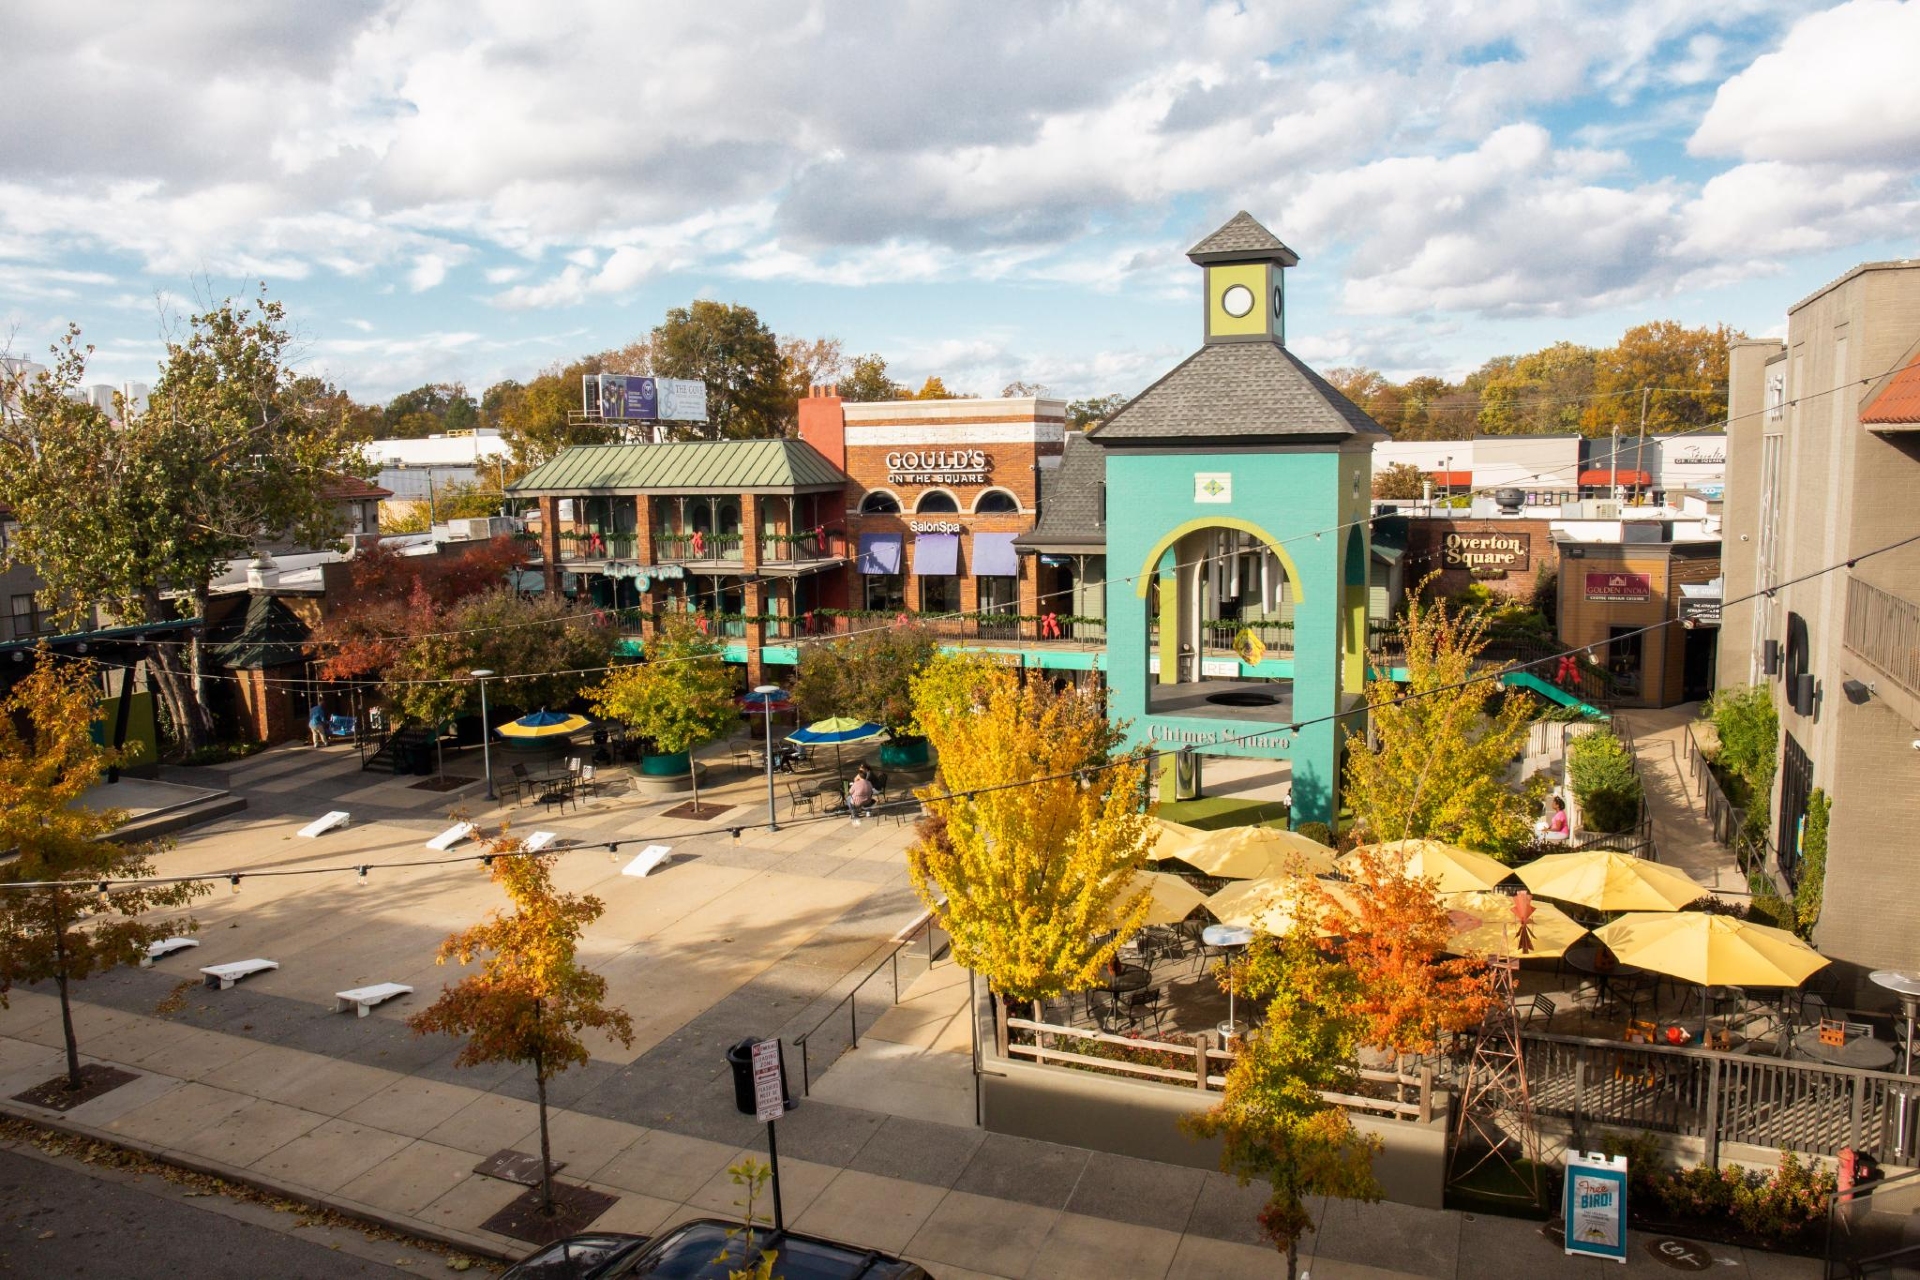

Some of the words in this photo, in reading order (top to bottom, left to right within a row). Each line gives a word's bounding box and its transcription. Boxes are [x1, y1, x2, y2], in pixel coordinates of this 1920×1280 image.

[885, 448, 985, 469] GOULD'S
[887, 474, 903, 483] ON
[910, 474, 931, 483] THE
[937, 474, 985, 485] SQUARE
[910, 520, 960, 534] SalonSpa
[1446, 533, 1524, 555] Overton
[1446, 548, 1515, 568] Square
[1587, 586, 1621, 594] GOLDEN
[1623, 587, 1648, 595] INDIA
[1147, 724, 1217, 744] Chimes
[1222, 728, 1290, 750] Square
[755, 1053, 777, 1064] LOADING
[760, 1060, 773, 1068] ZONE
[1578, 1180, 1609, 1195] Free
[1581, 1192, 1613, 1209] BIRD!
